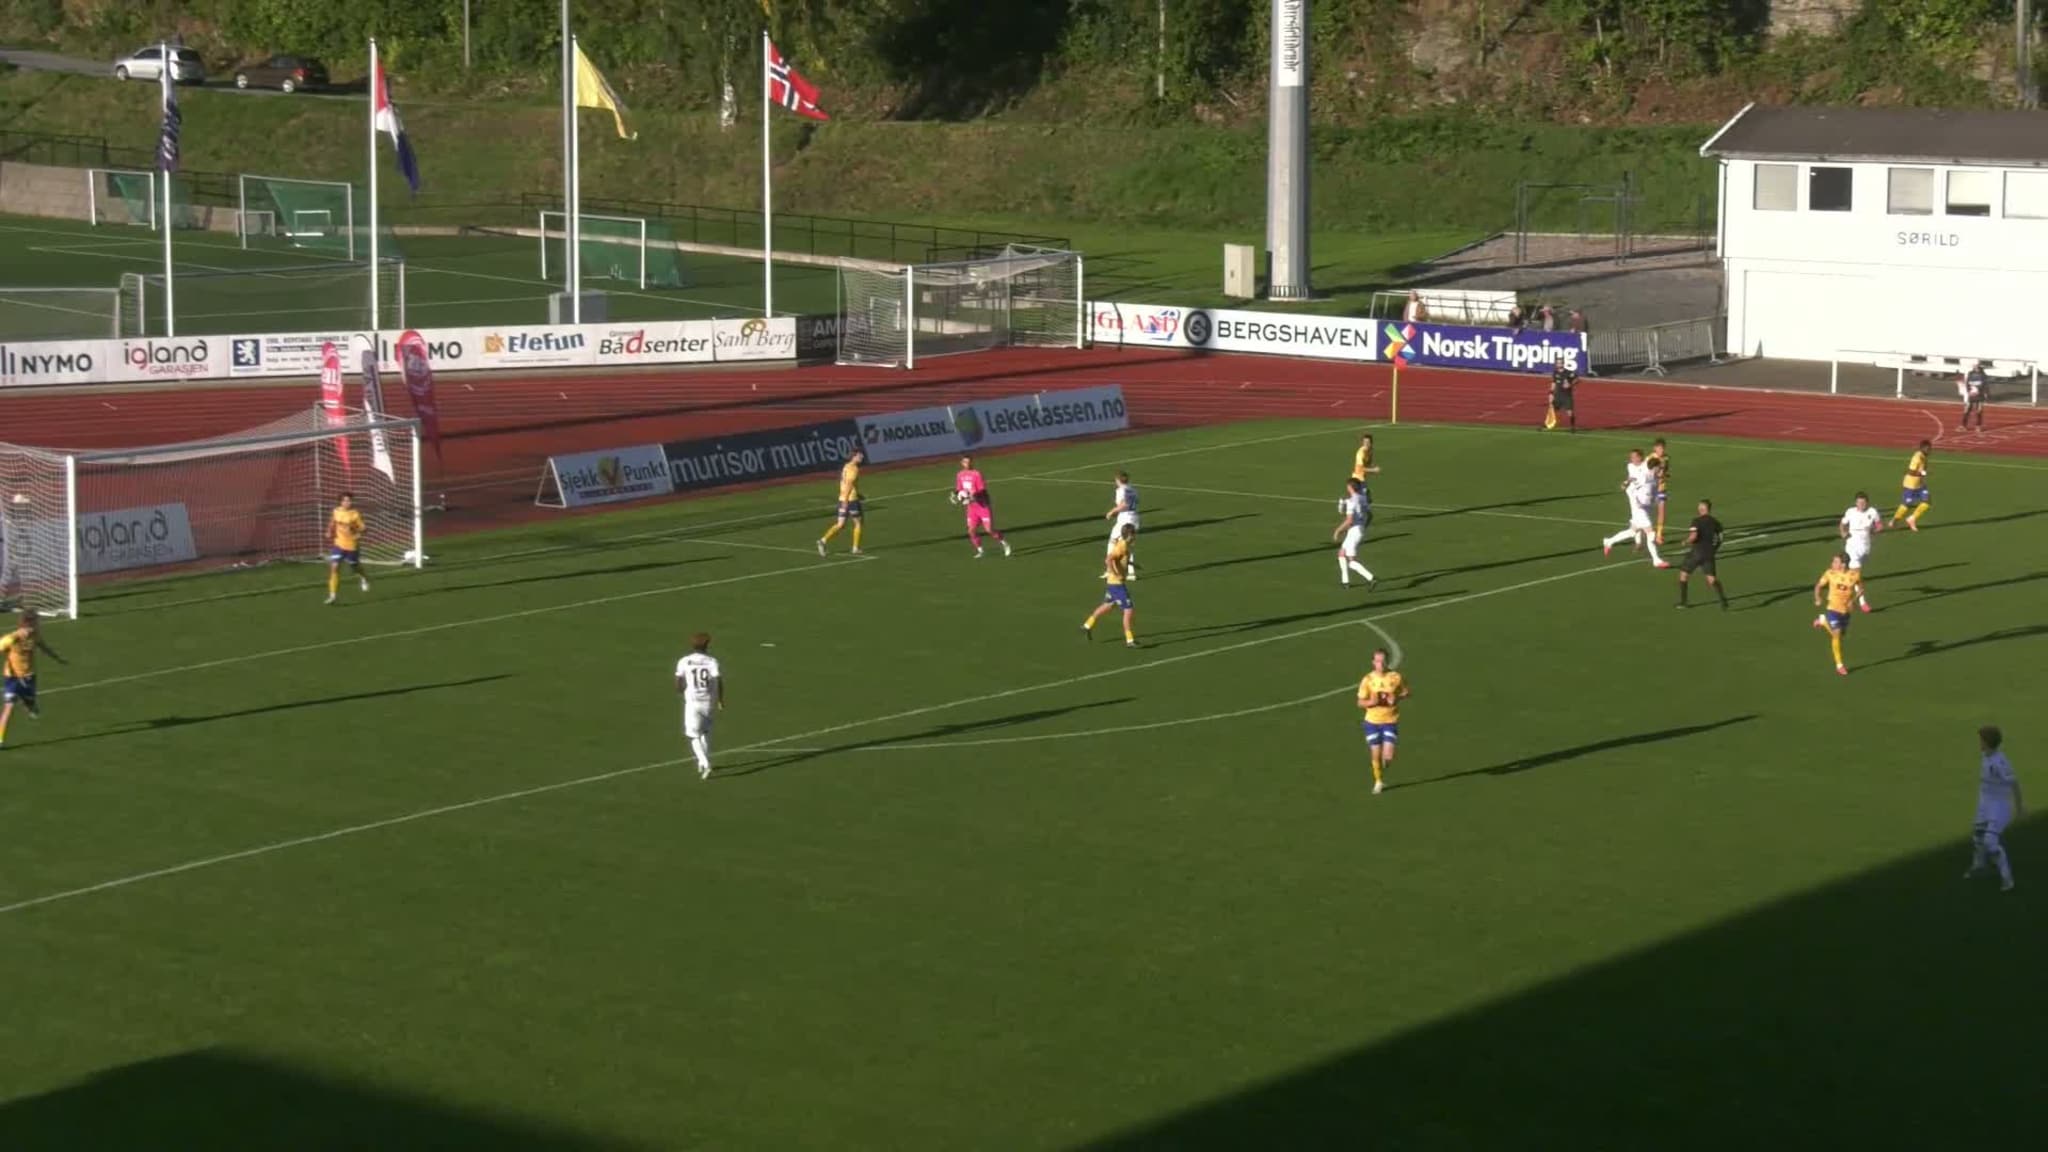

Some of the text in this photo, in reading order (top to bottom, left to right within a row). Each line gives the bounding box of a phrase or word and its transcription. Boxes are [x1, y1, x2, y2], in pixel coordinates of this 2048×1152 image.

[600, 329, 709, 354] Bådsenter
[756, 330, 796, 351] Berg
[1217, 319, 1369, 348] BERGSHAVEN
[21, 353, 93, 374] NYMO
[124, 340, 208, 370] igland
[1423, 331, 1580, 371] Norsk Tipping
[560, 466, 599, 493] Sjekk
[623, 461, 668, 481] Punkt
[671, 444, 767, 483] murisør
[691, 668, 709, 690] 19
